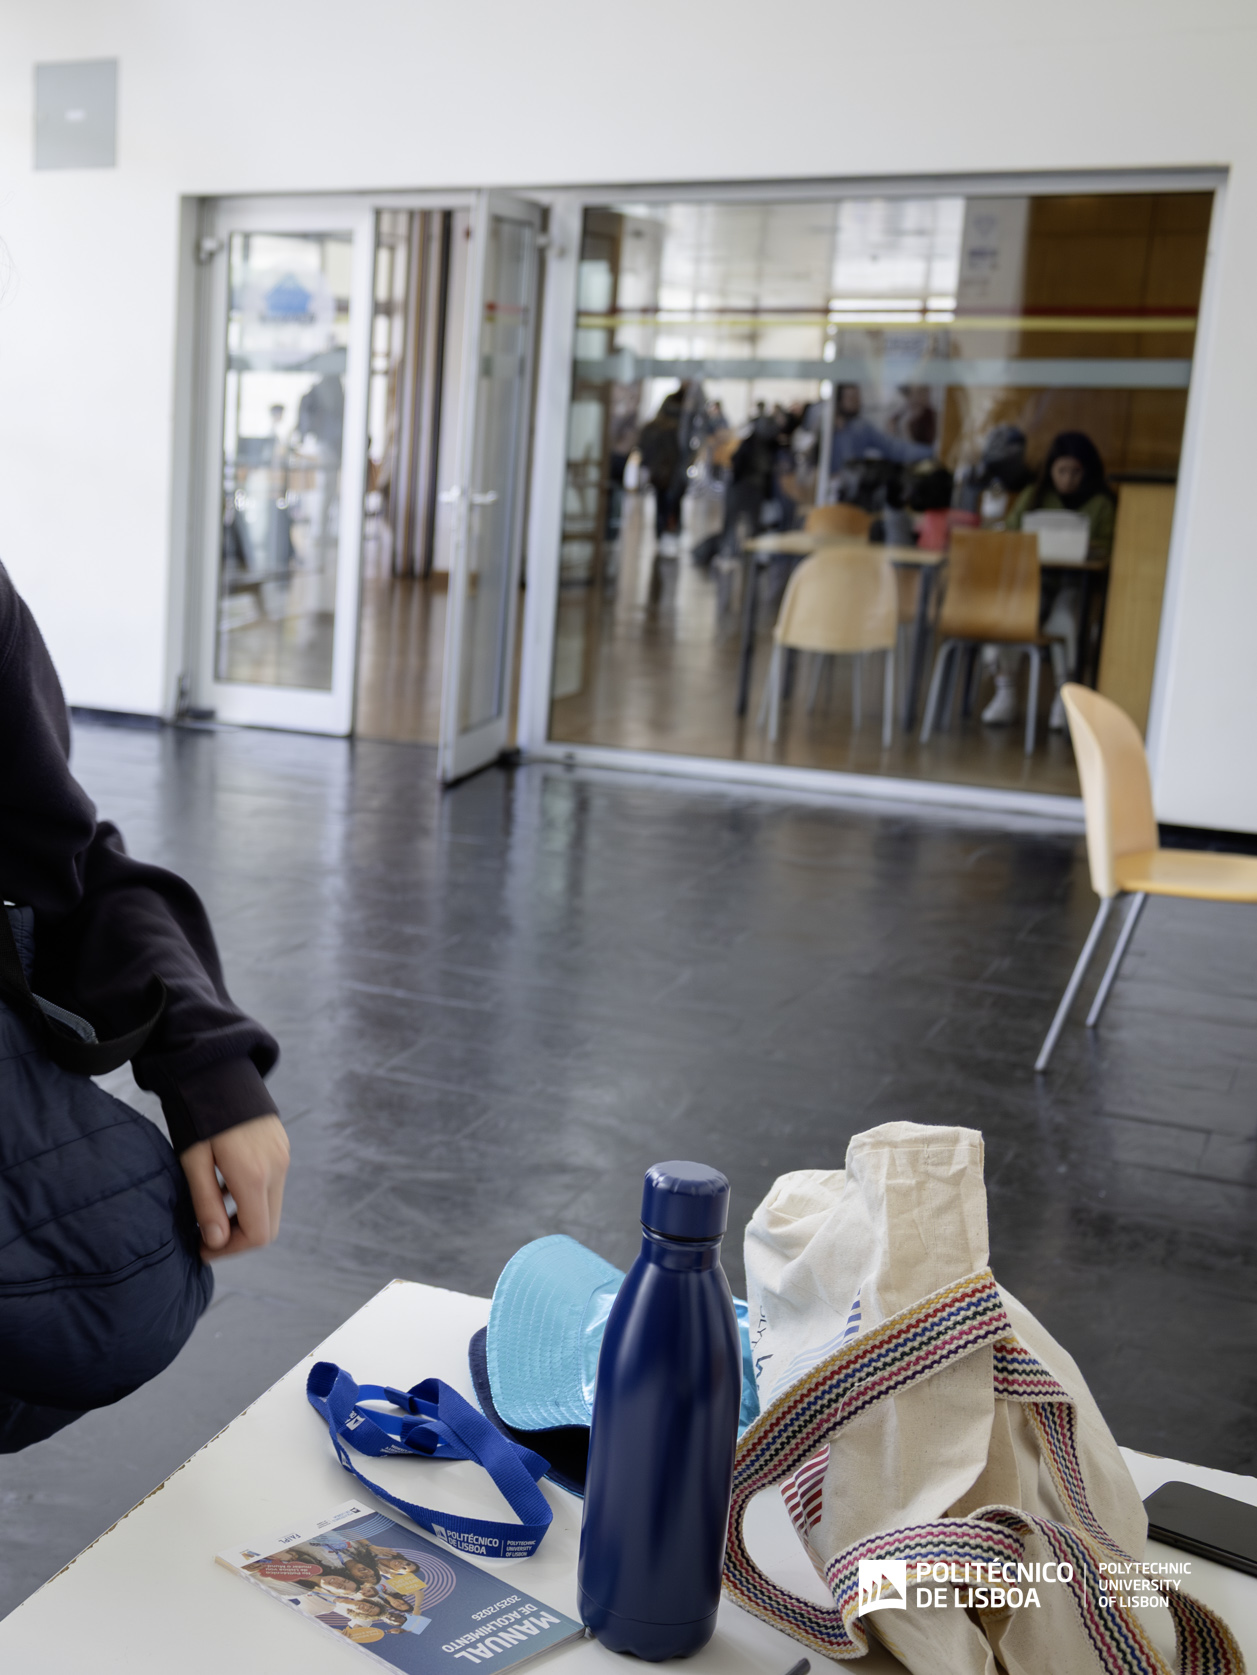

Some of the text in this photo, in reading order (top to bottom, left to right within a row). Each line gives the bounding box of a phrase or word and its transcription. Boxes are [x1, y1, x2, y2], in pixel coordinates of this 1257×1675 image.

[446, 1529, 500, 1548] POLITÉCNICO
[447, 1537, 487, 1555] DE LISBOA
[471, 1594, 522, 1621] 2025/2026
[517, 1603, 538, 1615] DE
[441, 1610, 522, 1653] ACOLHIMENTO
[453, 1611, 561, 1664] MANUAL
